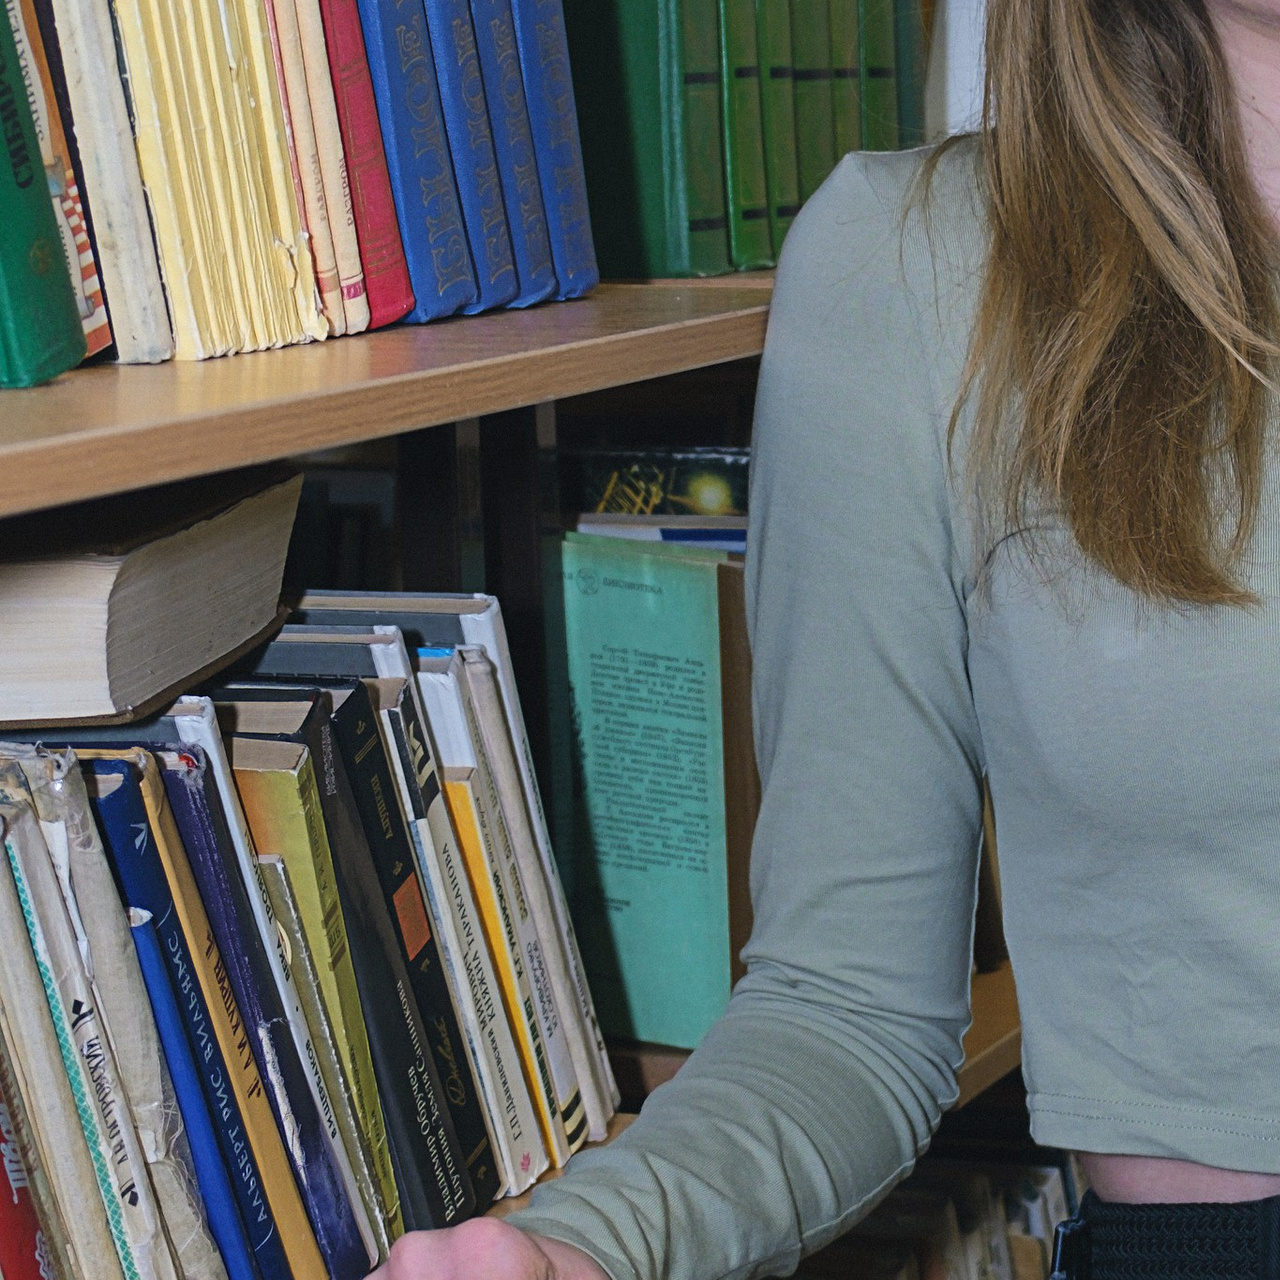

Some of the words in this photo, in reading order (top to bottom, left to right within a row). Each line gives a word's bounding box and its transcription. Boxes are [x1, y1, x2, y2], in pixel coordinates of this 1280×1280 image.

[0, 68, 35, 189] СИБИР
[337, 156, 353, 226] РАЗГРОМ
[602, 577, 663, 595] БИБЛИОТЕКА
[440, 842, 474, 947] ТАРАКАНОВА
[490, 870, 516, 950] УМАНСКИЙ
[165, 929, 215, 1064] ВИЛЬЯМС
[210, 956, 242, 1034] КУПРИН
[461, 950, 488, 1029] МИРОВИЧ
[470, 949, 494, 1020] КНЯЖНА
[395, 979, 426, 1071] Санникова
[77, 1034, 122, 1139] ОСТРОВСКИЙ
[209, 1066, 235, 1121] РИС
[406, 1065, 433, 1135] Обручев
[228, 1125, 268, 1223] АЛЬБЕРТ
[425, 1134, 456, 1221] Владимир
[437, 1127, 465, 1207] Плутония
